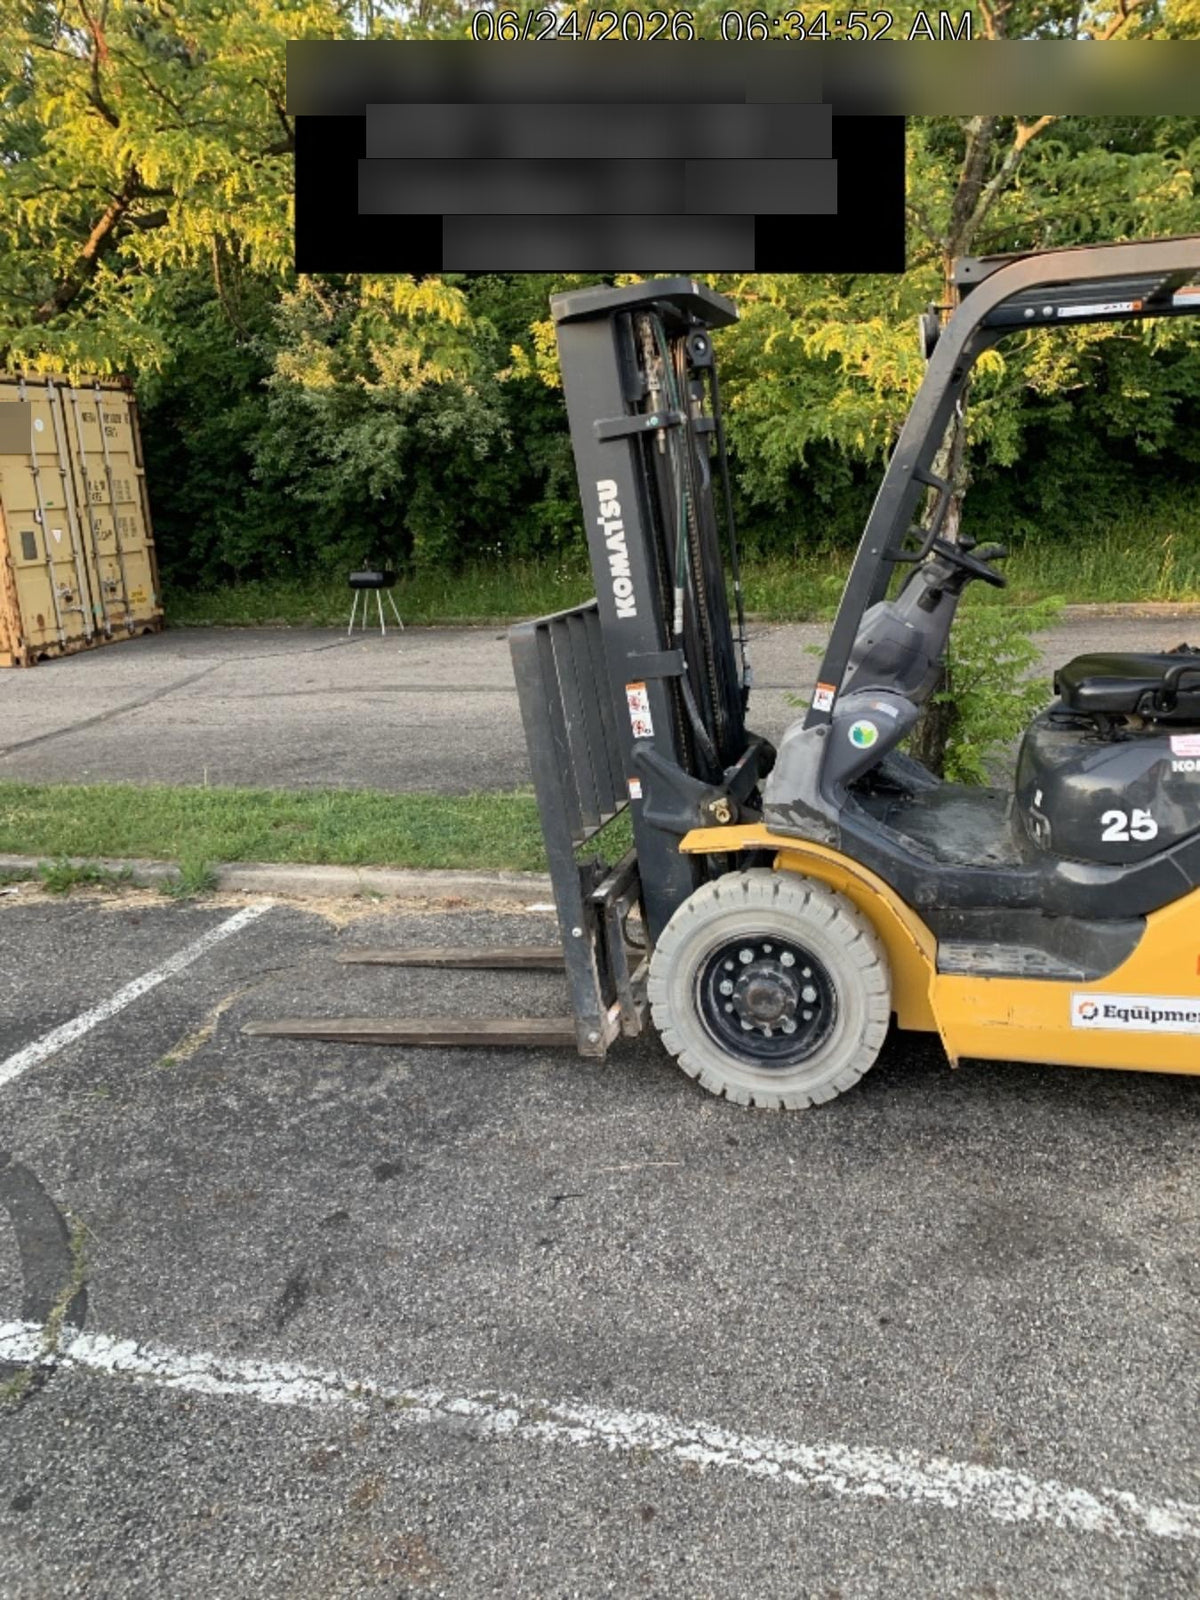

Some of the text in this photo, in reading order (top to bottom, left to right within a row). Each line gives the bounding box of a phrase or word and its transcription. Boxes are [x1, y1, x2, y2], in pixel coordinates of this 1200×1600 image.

[596, 479, 638, 619] KOMATSU
[1171, 758, 1200, 773] KO
[1101, 808, 1159, 842] 25
[1103, 1005, 1200, 1023] Equipme
